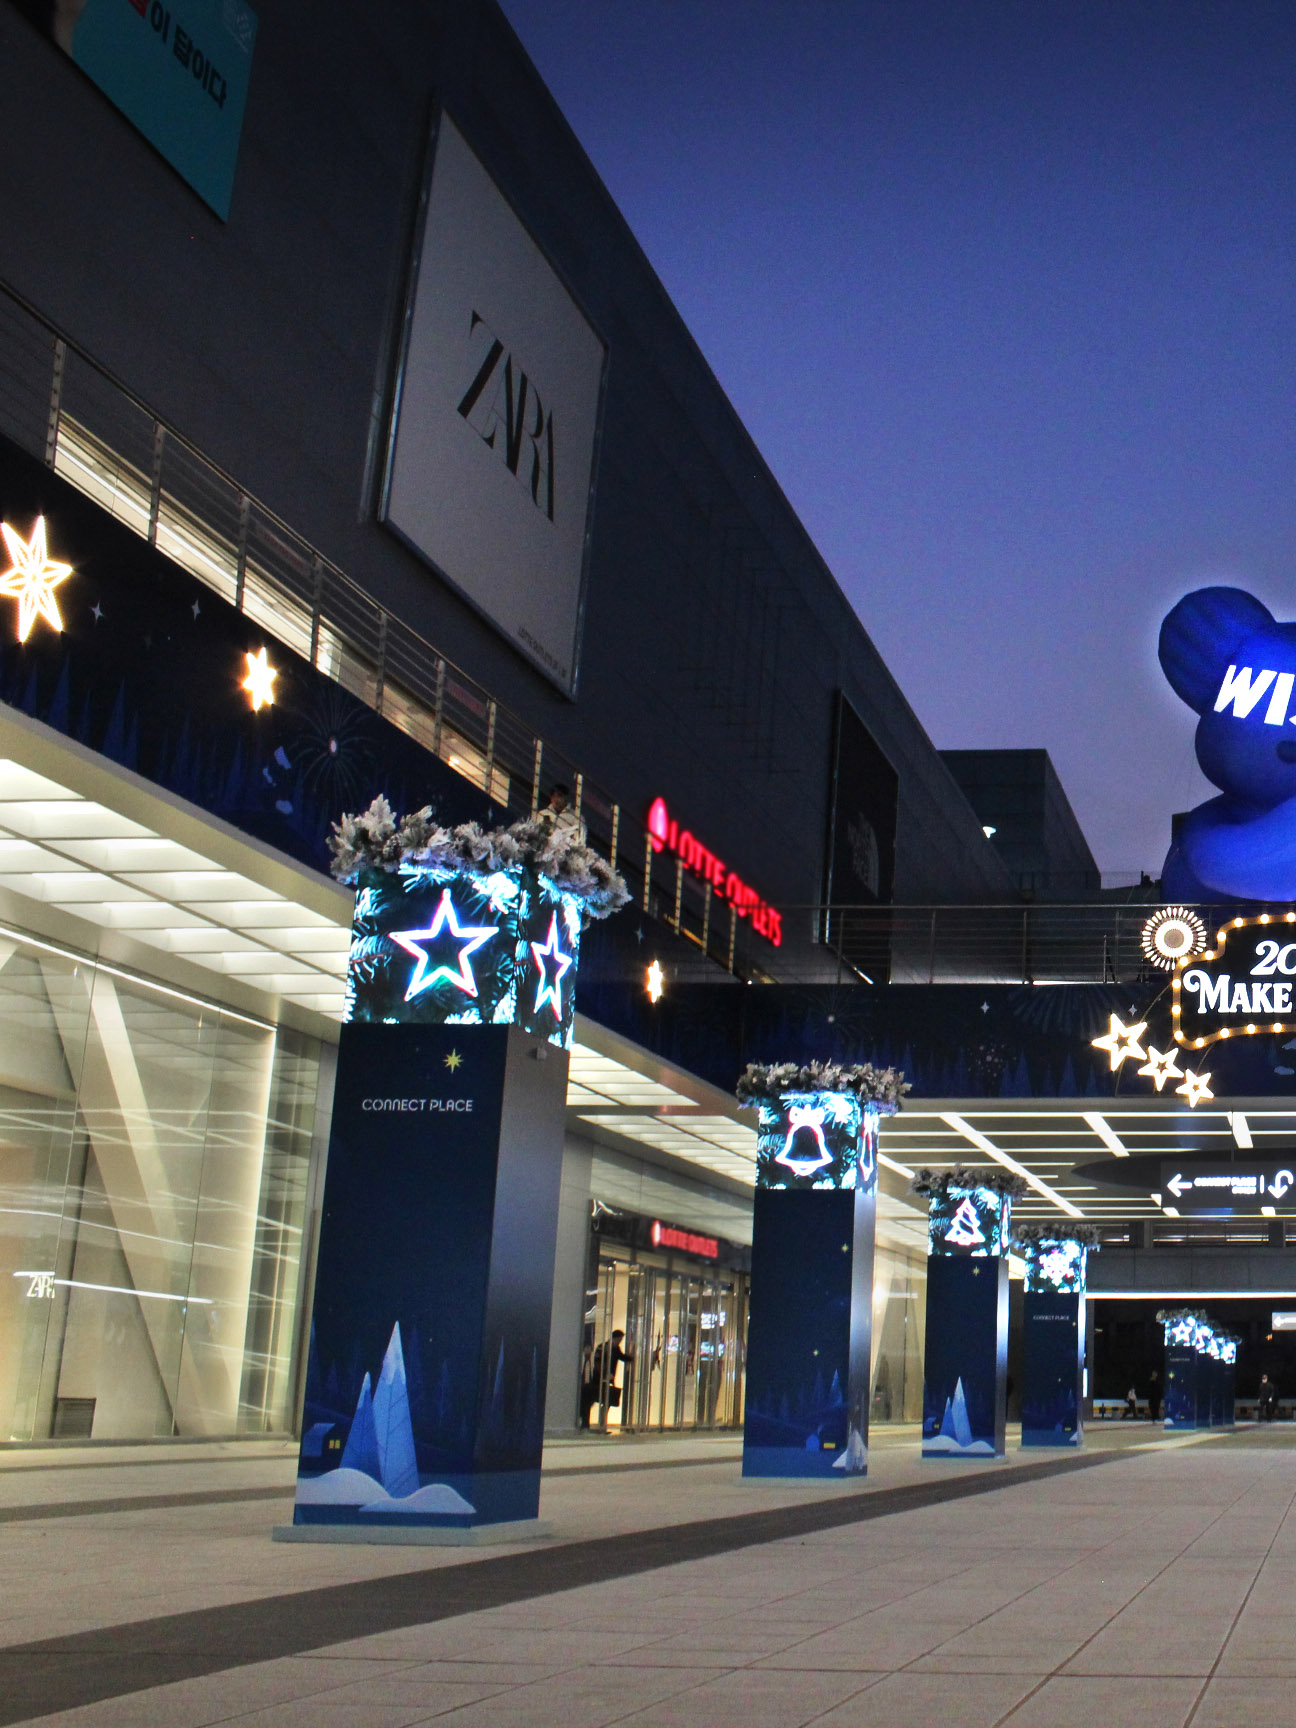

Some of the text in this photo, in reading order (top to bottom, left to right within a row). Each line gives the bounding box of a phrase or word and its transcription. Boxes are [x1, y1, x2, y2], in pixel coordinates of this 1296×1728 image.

[457, 309, 557, 524] ZARA
[1182, 969, 1293, 1014] MAKE
[361, 1098, 474, 1113] CONNECT PLACE
